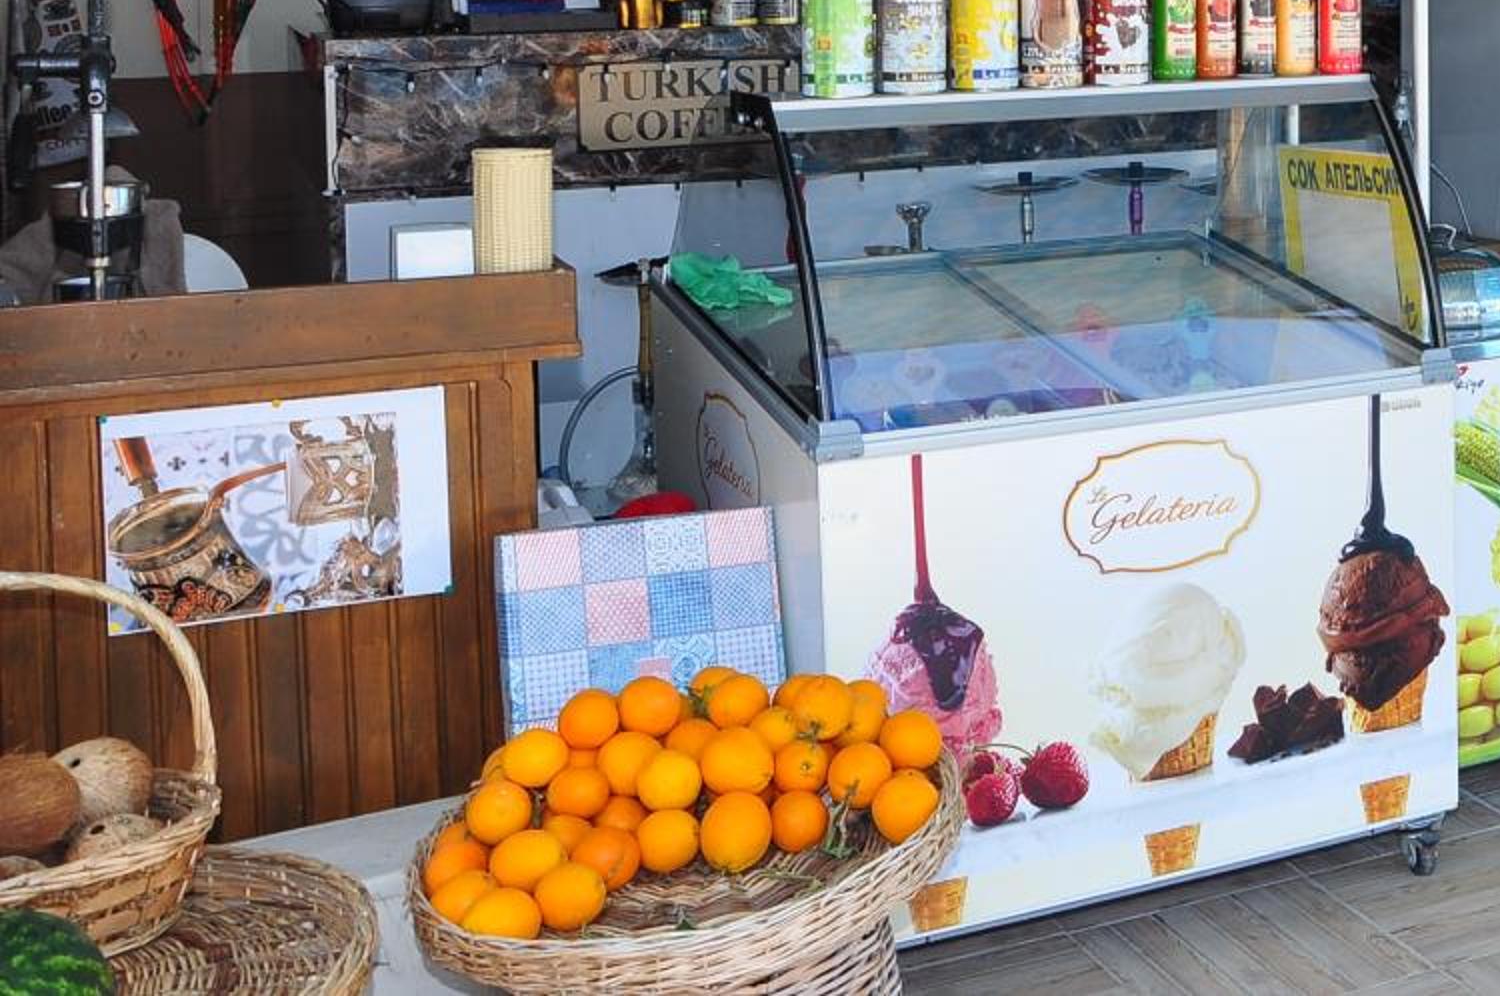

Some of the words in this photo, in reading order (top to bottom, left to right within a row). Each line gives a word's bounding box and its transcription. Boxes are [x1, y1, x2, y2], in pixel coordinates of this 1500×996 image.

[604, 106, 749, 143] COFF
[1287, 159, 1320, 189] СОК
[1089, 493, 1238, 544] Gelateria
